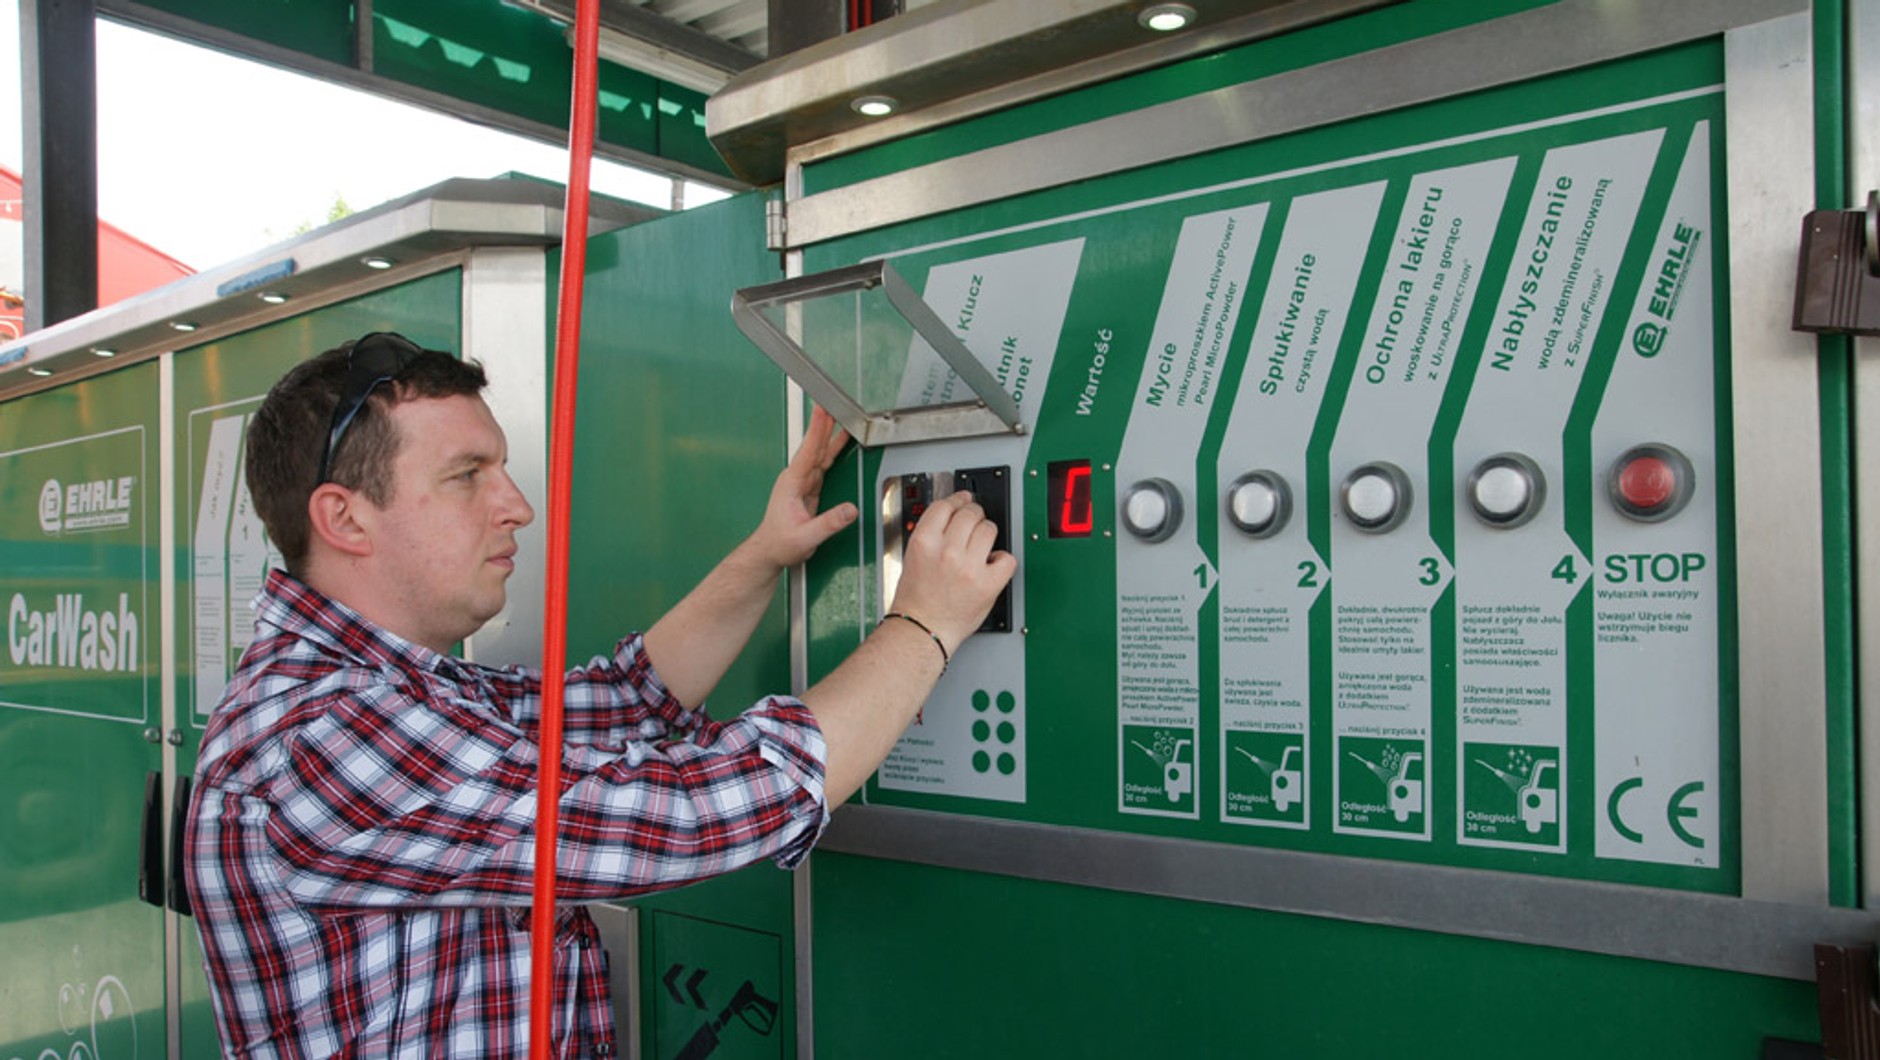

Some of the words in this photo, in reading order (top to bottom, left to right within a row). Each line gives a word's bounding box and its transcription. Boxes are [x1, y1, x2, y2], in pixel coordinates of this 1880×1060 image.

[1366, 279, 1414, 385] Ochrona
[1401, 186, 1443, 271] lakieru
[1491, 176, 1573, 372] Nabłyszczanie
[1647, 222, 1694, 318] EHRLE
[957, 274, 984, 332] Klucz
[1177, 303, 1212, 407] mikroproszkiem
[1206, 217, 1236, 301] ActivePower
[1404, 294, 1438, 383] woskowanie
[1433, 272, 1445, 291] na
[1440, 217, 1463, 269] gorąco
[1194, 371, 1212, 405] Pearl
[1205, 281, 1238, 369] MicroPowder
[1260, 253, 1316, 396] Spłukiwanie
[1075, 328, 1113, 416] Wartość
[1146, 342, 1177, 407] Mycie
[1296, 349, 1318, 393] czystą
[1310, 308, 1330, 346] wodą
[1564, 358, 1575, 367] z
[1428, 372, 1438, 381] z
[66, 476, 133, 514] EHRLE
[1193, 563, 1207, 589] 1
[1297, 561, 1318, 588] 2
[1418, 558, 1441, 586] 3
[1550, 555, 1577, 584] 4
[1604, 553, 1706, 583] STOP
[1597, 589, 1648, 599] Wyłącznik
[1651, 589, 1699, 600] awaryjny
[1597, 611, 1635, 621] Uwaga!
[1676, 612, 1692, 620] nie
[8, 592, 138, 672] CarWash
[1658, 623, 1689, 633] biegu
[1354, 814, 1369, 822] cm
[1480, 823, 1497, 833] cm
[1607, 777, 1704, 848] CE
